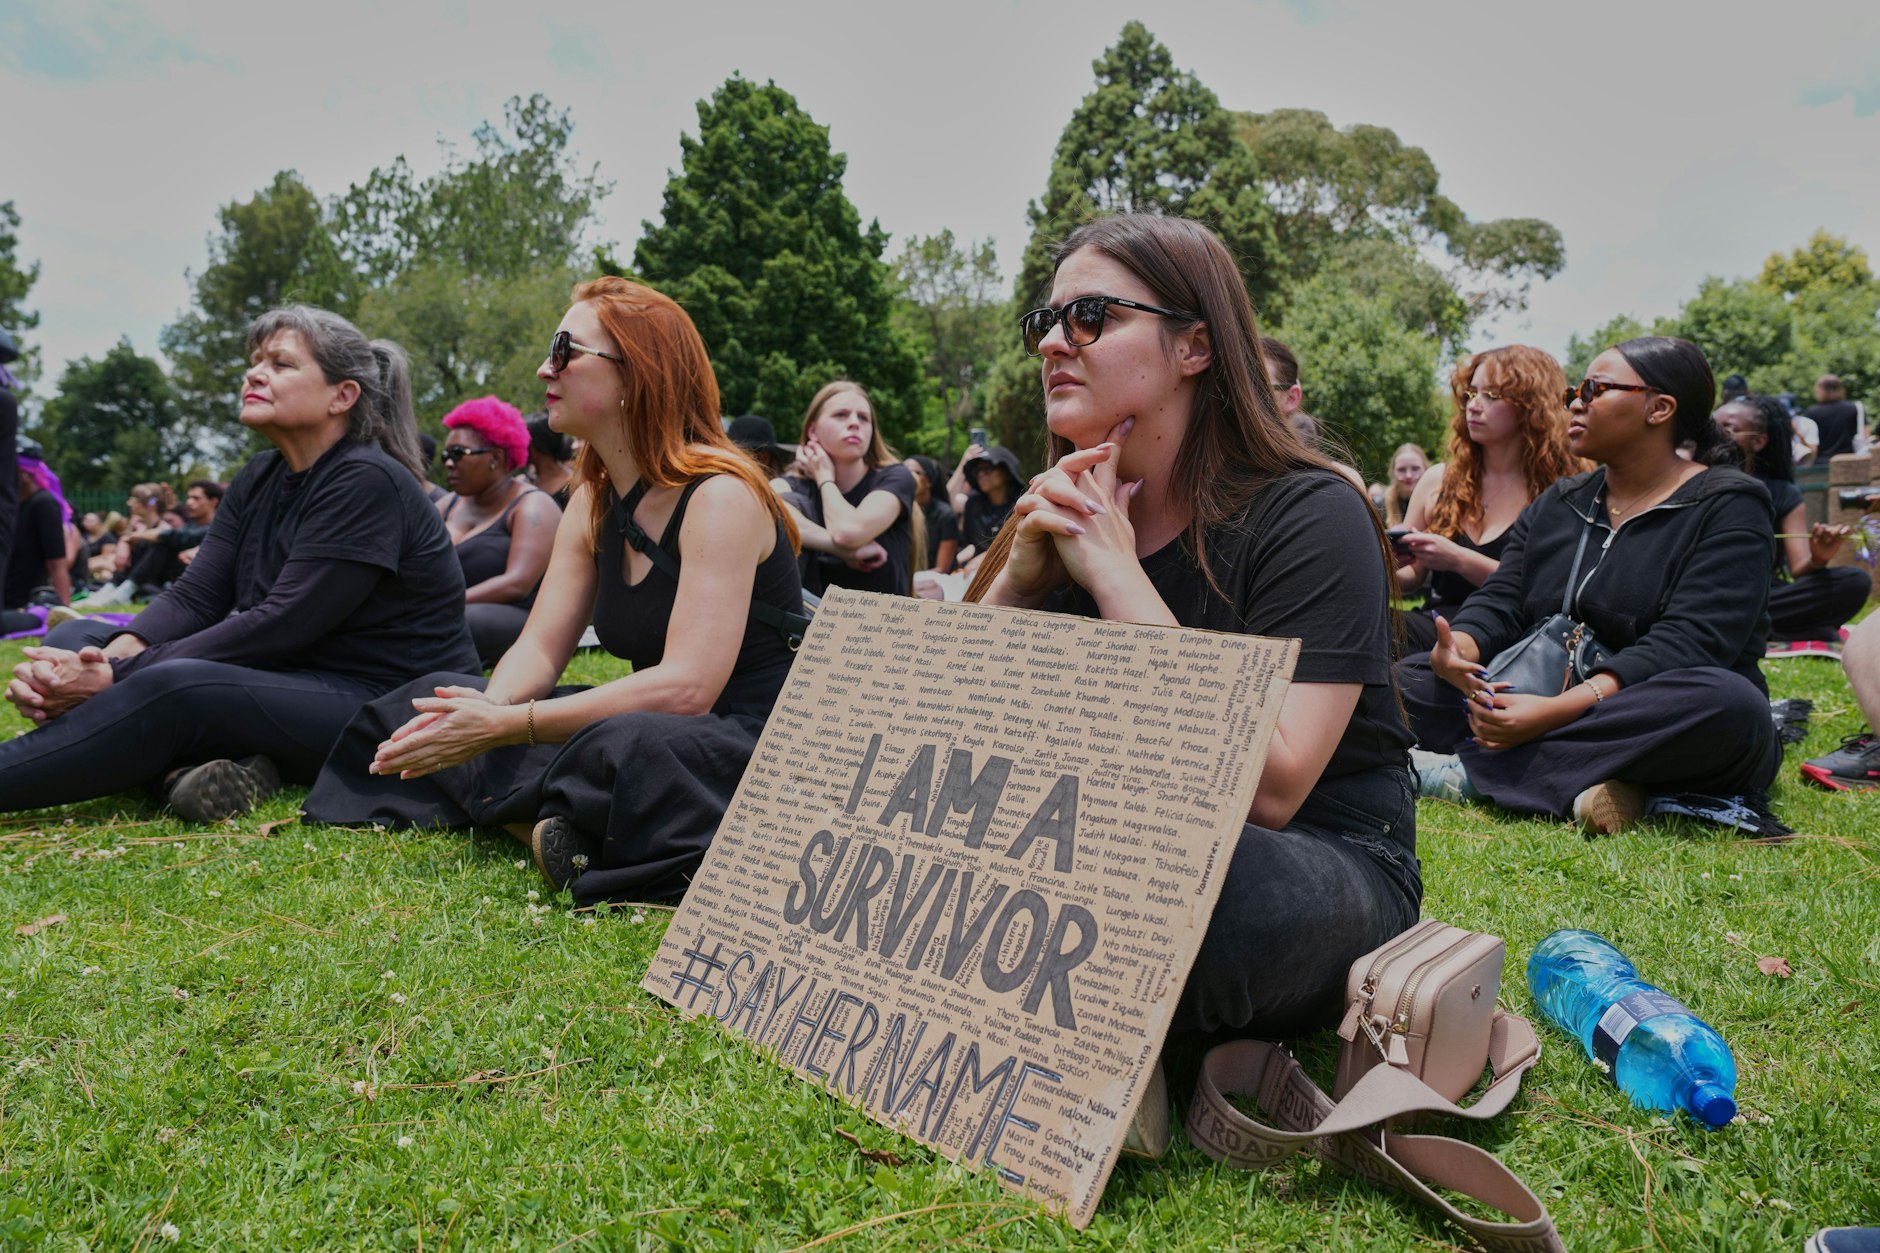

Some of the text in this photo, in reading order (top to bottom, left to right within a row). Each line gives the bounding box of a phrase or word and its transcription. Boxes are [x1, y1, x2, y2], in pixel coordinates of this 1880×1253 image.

[1000, 627, 1025, 638] Angela
[1075, 637, 1102, 647] Junior
[1149, 645, 1168, 655] Tina
[1010, 615, 1038, 627] Rebecca
[1093, 627, 1126, 637] Melanie
[1179, 633, 1212, 646] Dimpho
[1084, 663, 1118, 675] Koketso
[1159, 673, 1190, 686] Ayanda
[1134, 733, 1172, 746] Peaceful
[843, 733, 1079, 873] I AM A
[1075, 859, 1097, 872] Zinzi
[783, 830, 1100, 1030] SURVIVOR
[670, 933, 1063, 1187] #SAYHERNAME
[1006, 1128, 1034, 1146] Maria
[1209, 1115, 1285, 1158] ROAD
